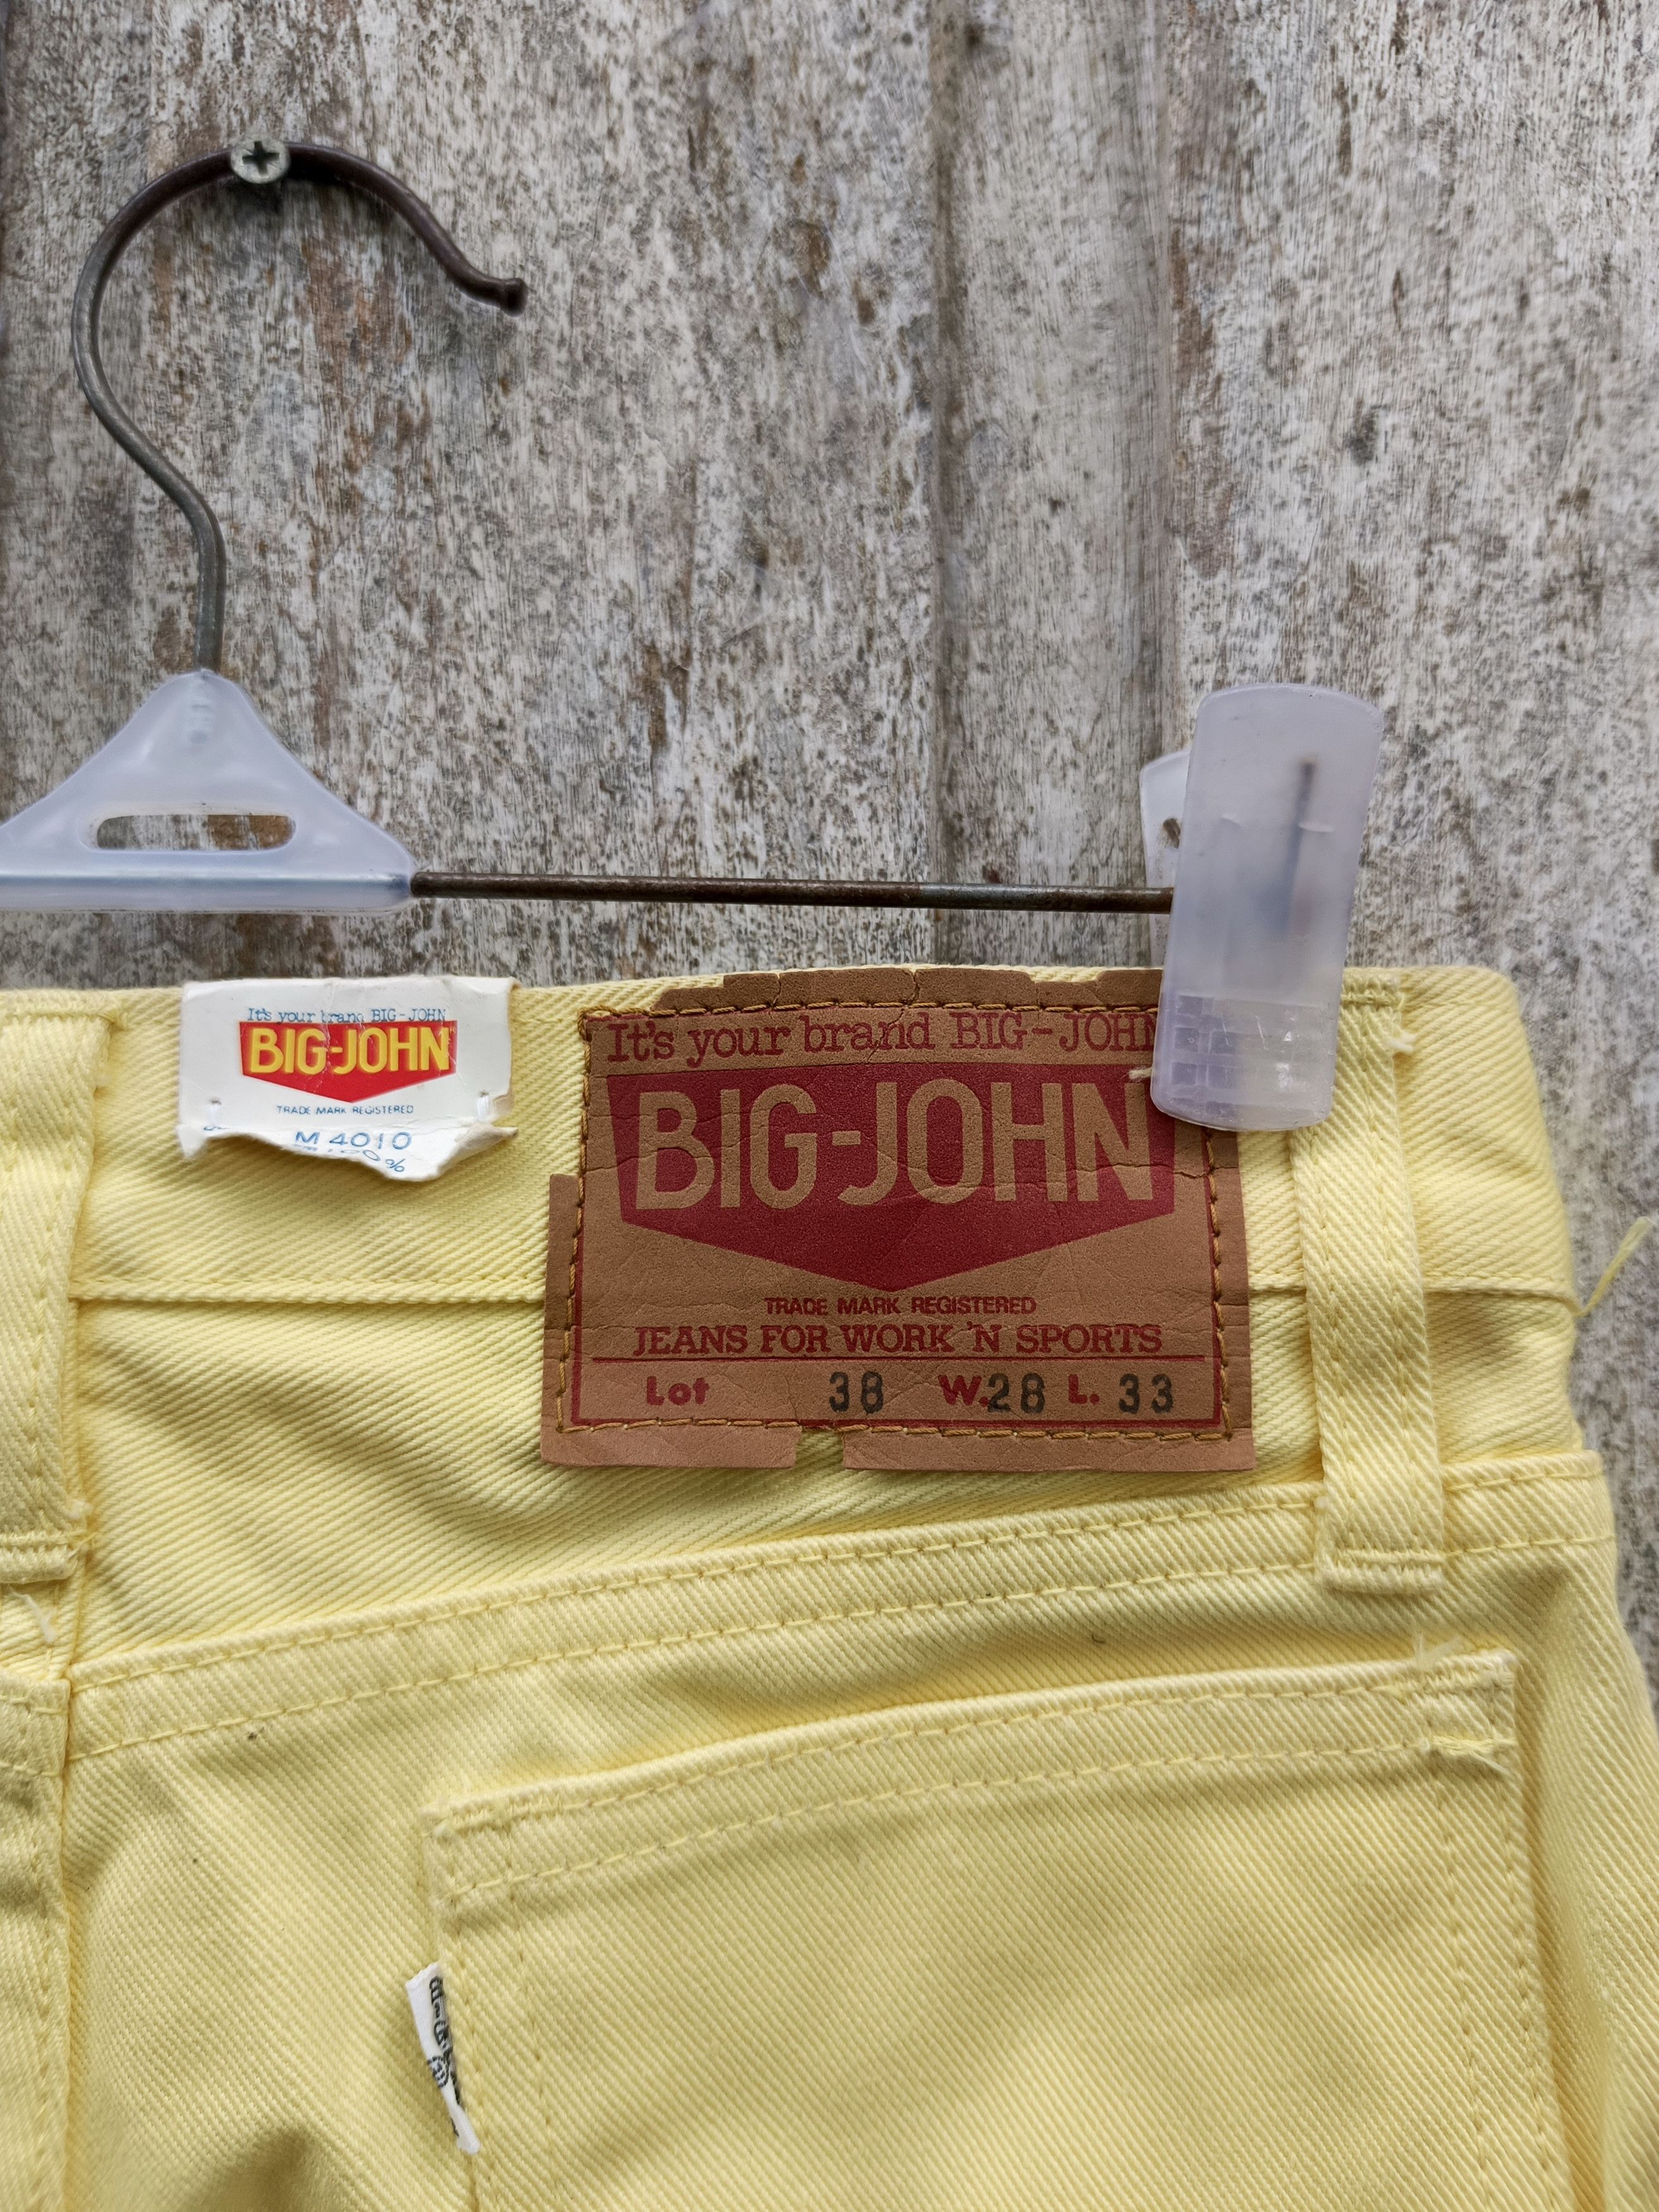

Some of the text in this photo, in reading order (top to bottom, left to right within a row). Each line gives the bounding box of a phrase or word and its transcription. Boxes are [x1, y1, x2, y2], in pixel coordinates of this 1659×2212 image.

[248, 1008, 272, 1021] It's
[278, 1011, 315, 1024] your
[251, 1027, 449, 1074] BIG-JOHN
[607, 1021, 675, 1063] It's
[687, 1026, 791, 1068] your
[798, 1015, 935, 1054] brand
[277, 1105, 414, 1115] TRADE MARK REGISTERED
[295, 1131, 321, 1145] M
[329, 1131, 412, 1150] 4010
[636, 1078, 1153, 1210] BIG-JOHN
[764, 1296, 1036, 1316] TRADE MARK REGISTERED
[633, 1321, 1163, 1357] JEANS FOR WORK 'N SPORTS
[646, 1376, 710, 1406] Lot
[829, 1370, 884, 1415] 38
[987, 1372, 1046, 1414] 28
[1067, 1373, 1100, 1406] L.
[1118, 1373, 1174, 1414] 33
